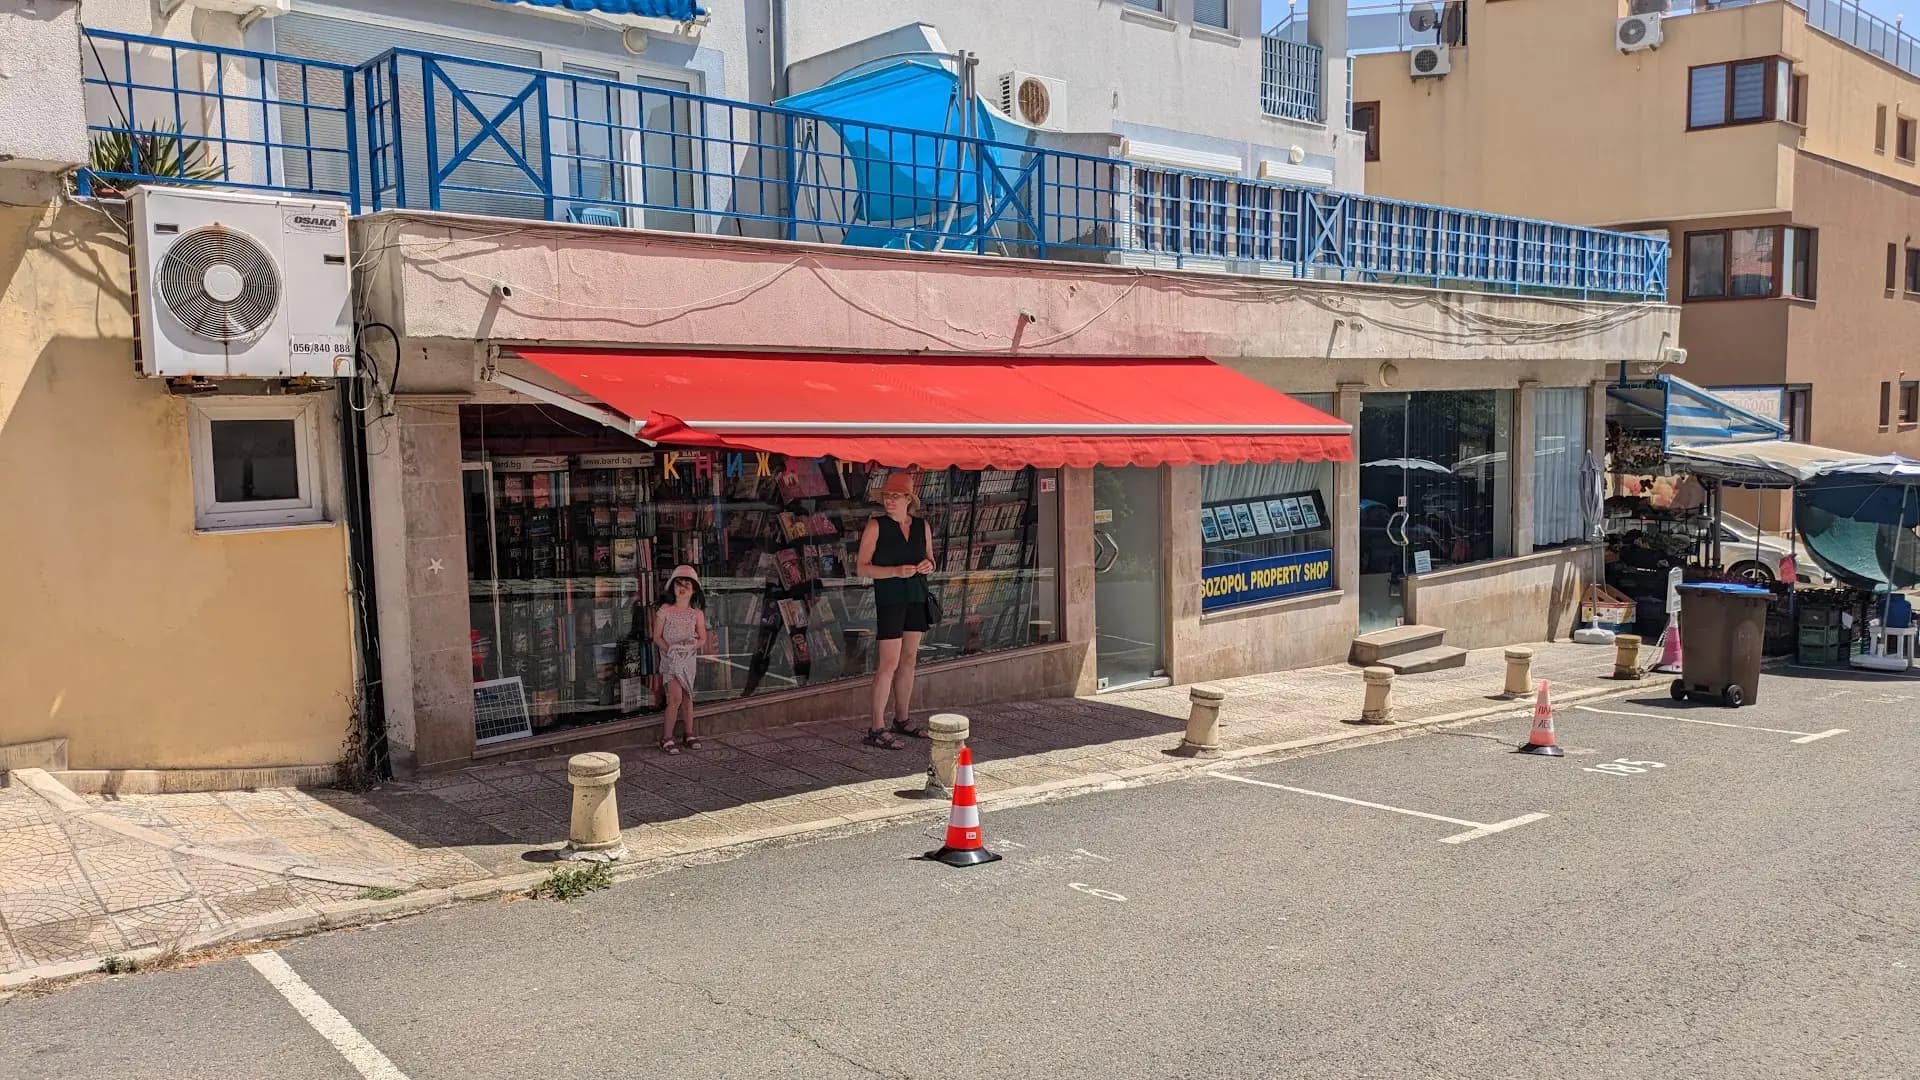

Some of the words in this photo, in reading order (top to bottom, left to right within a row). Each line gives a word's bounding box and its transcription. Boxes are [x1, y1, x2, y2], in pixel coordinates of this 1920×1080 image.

[294, 216, 337, 227] OSAKA
[293, 343, 330, 354] 056/840
[583, 455, 633, 466] www.bard.bg
[1201, 572, 1248, 599] SOZOPOL
[1250, 564, 1302, 590] PROPERTY
[1303, 560, 1329, 581] SHOP
[1582, 757, 1667, 777] 185
